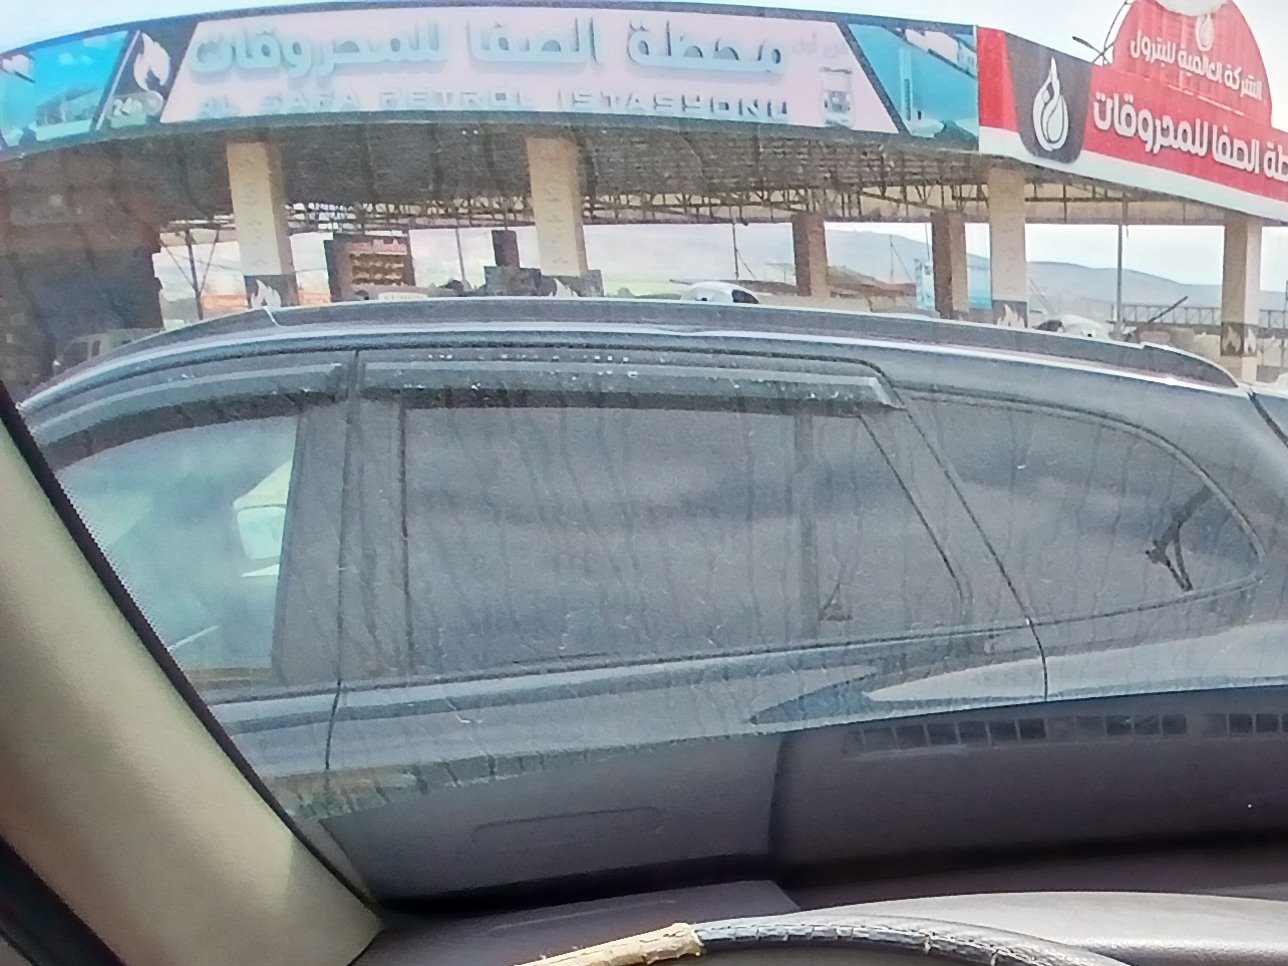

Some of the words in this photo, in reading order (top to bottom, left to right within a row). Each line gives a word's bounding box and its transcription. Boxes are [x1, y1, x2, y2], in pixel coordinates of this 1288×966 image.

[468, 16, 600, 64] الصفا
[626, 19, 786, 73] محطة
[1130, 29, 1176, 67] للبترول
[1224, 64, 1263, 101] الشركة
[1092, 91, 1209, 158] للمحروقات
[1212, 123, 1260, 174] الصفا
